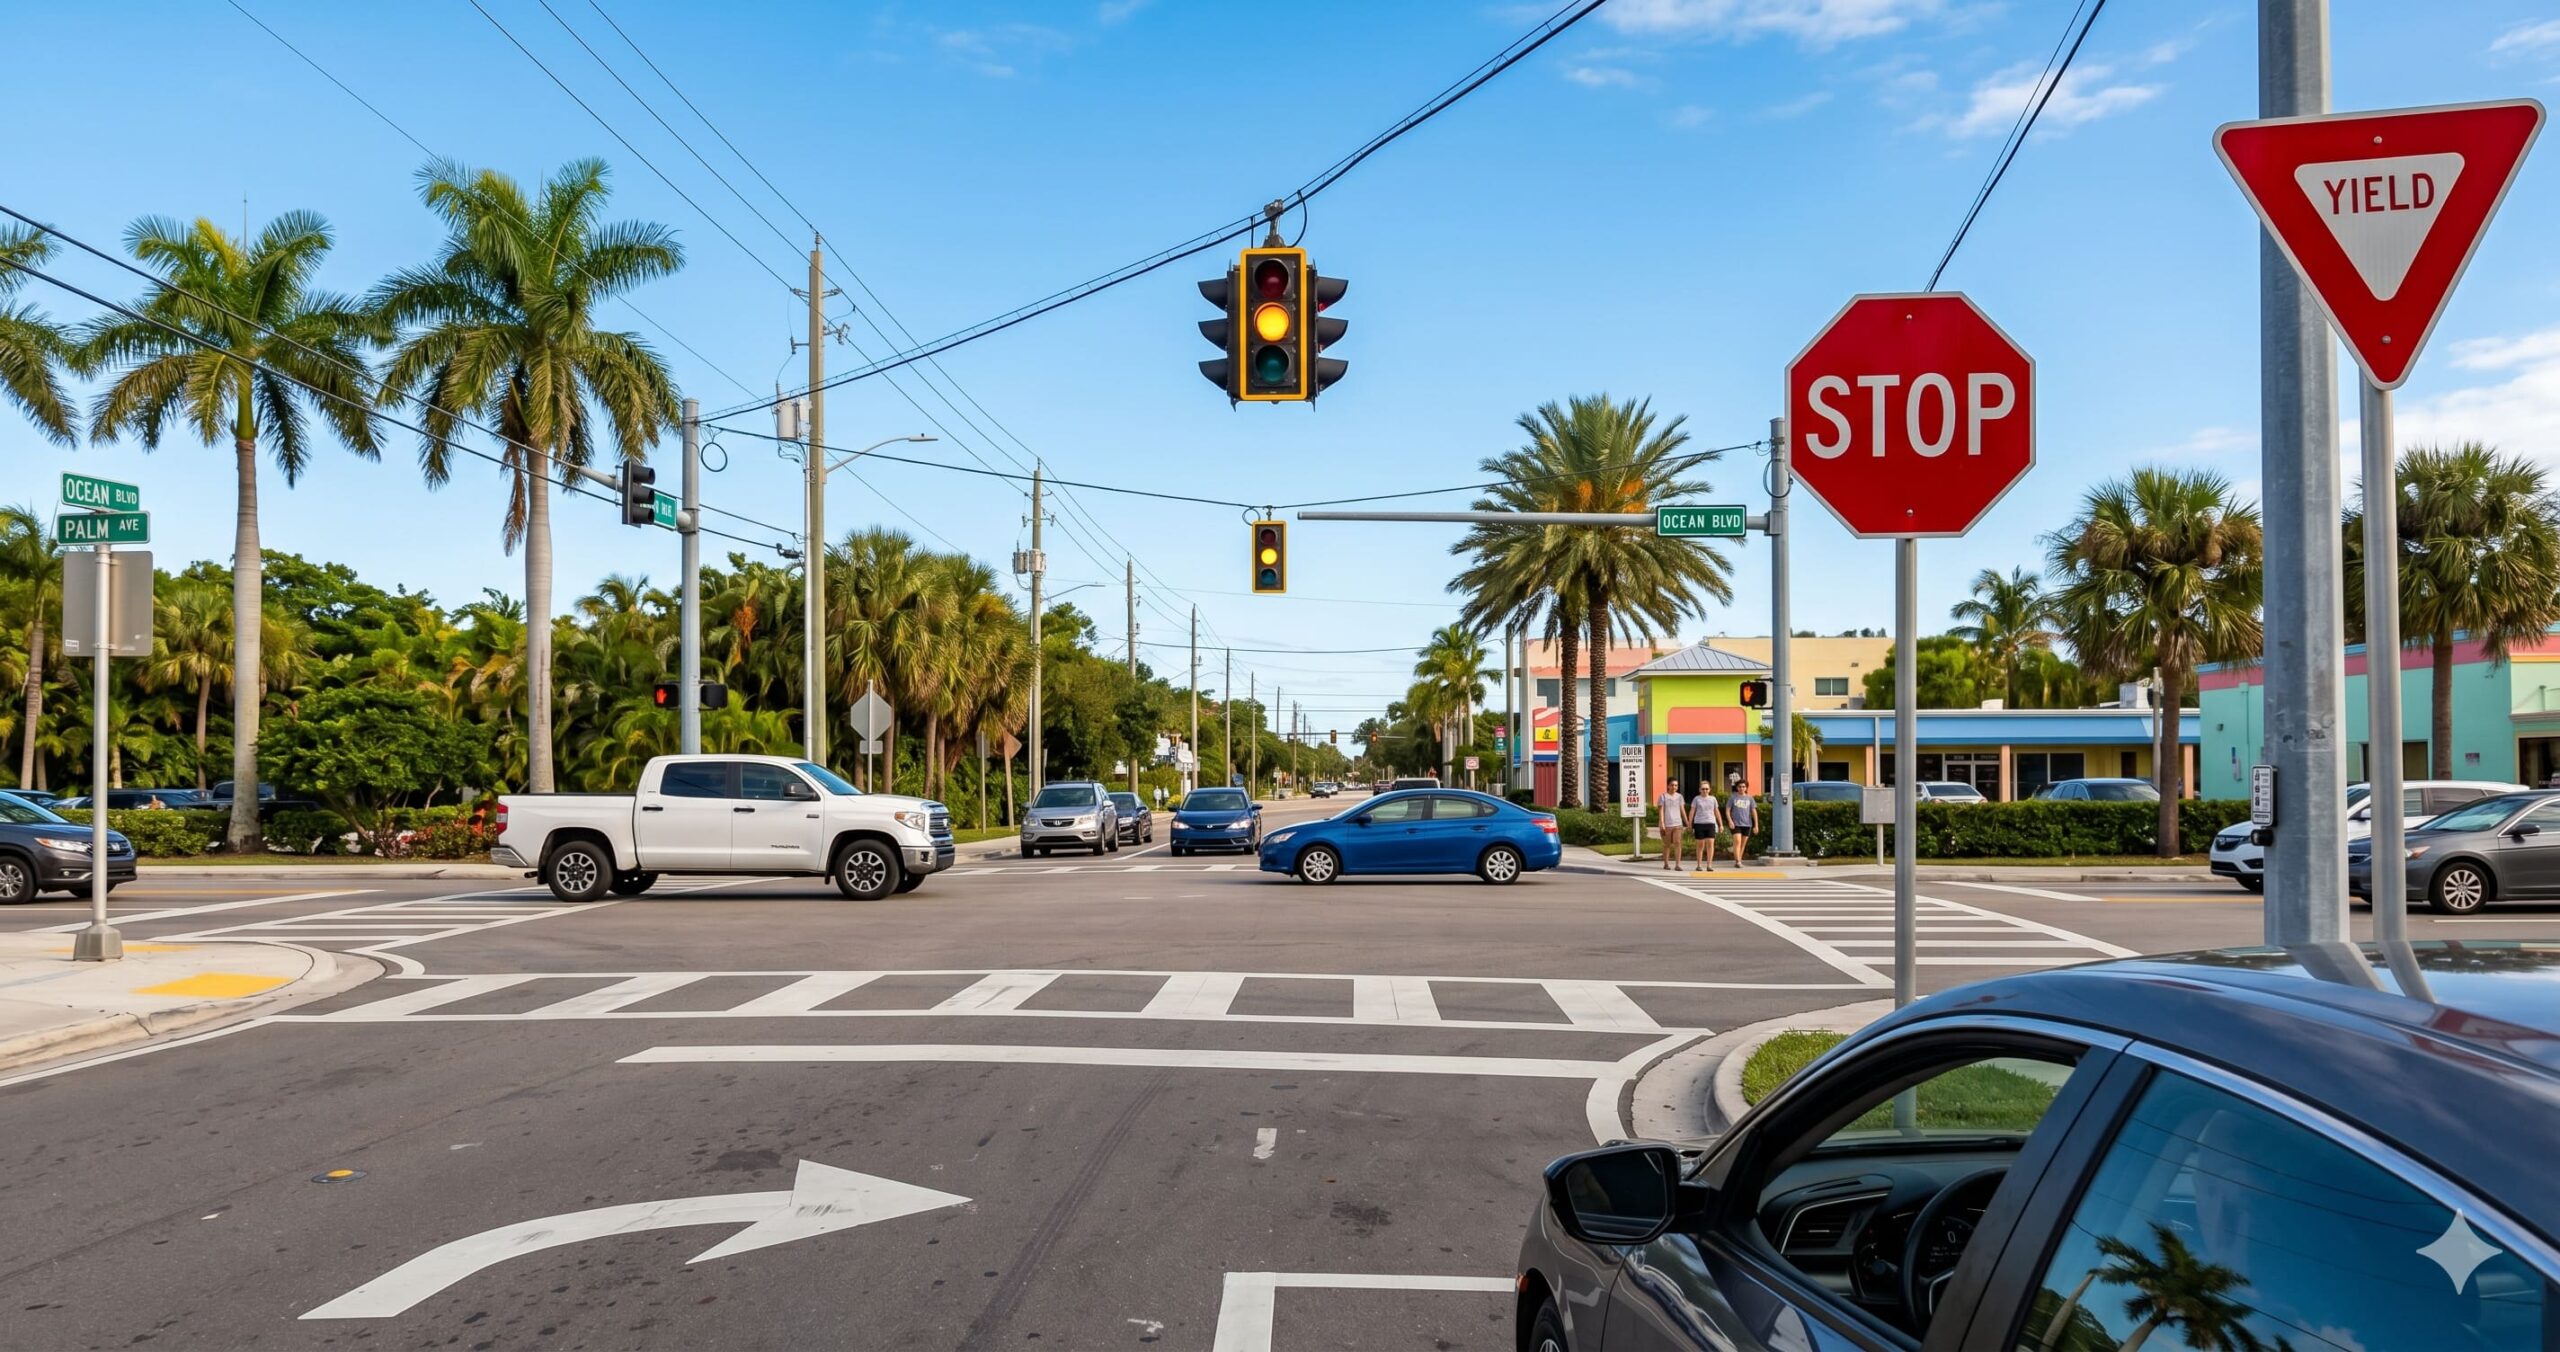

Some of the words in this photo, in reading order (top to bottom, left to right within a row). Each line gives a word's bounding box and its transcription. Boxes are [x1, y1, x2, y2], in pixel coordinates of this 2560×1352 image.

[2323, 172, 2435, 215] YIELD
[1805, 372, 2016, 460] STOP
[65, 478, 110, 506] OCEAN
[115, 488, 138, 505] BLVD
[64, 519, 109, 539] PALM
[118, 518, 140, 531] AVE
[1663, 514, 1705, 529] OCEAN
[1712, 514, 1741, 529] BLVD
